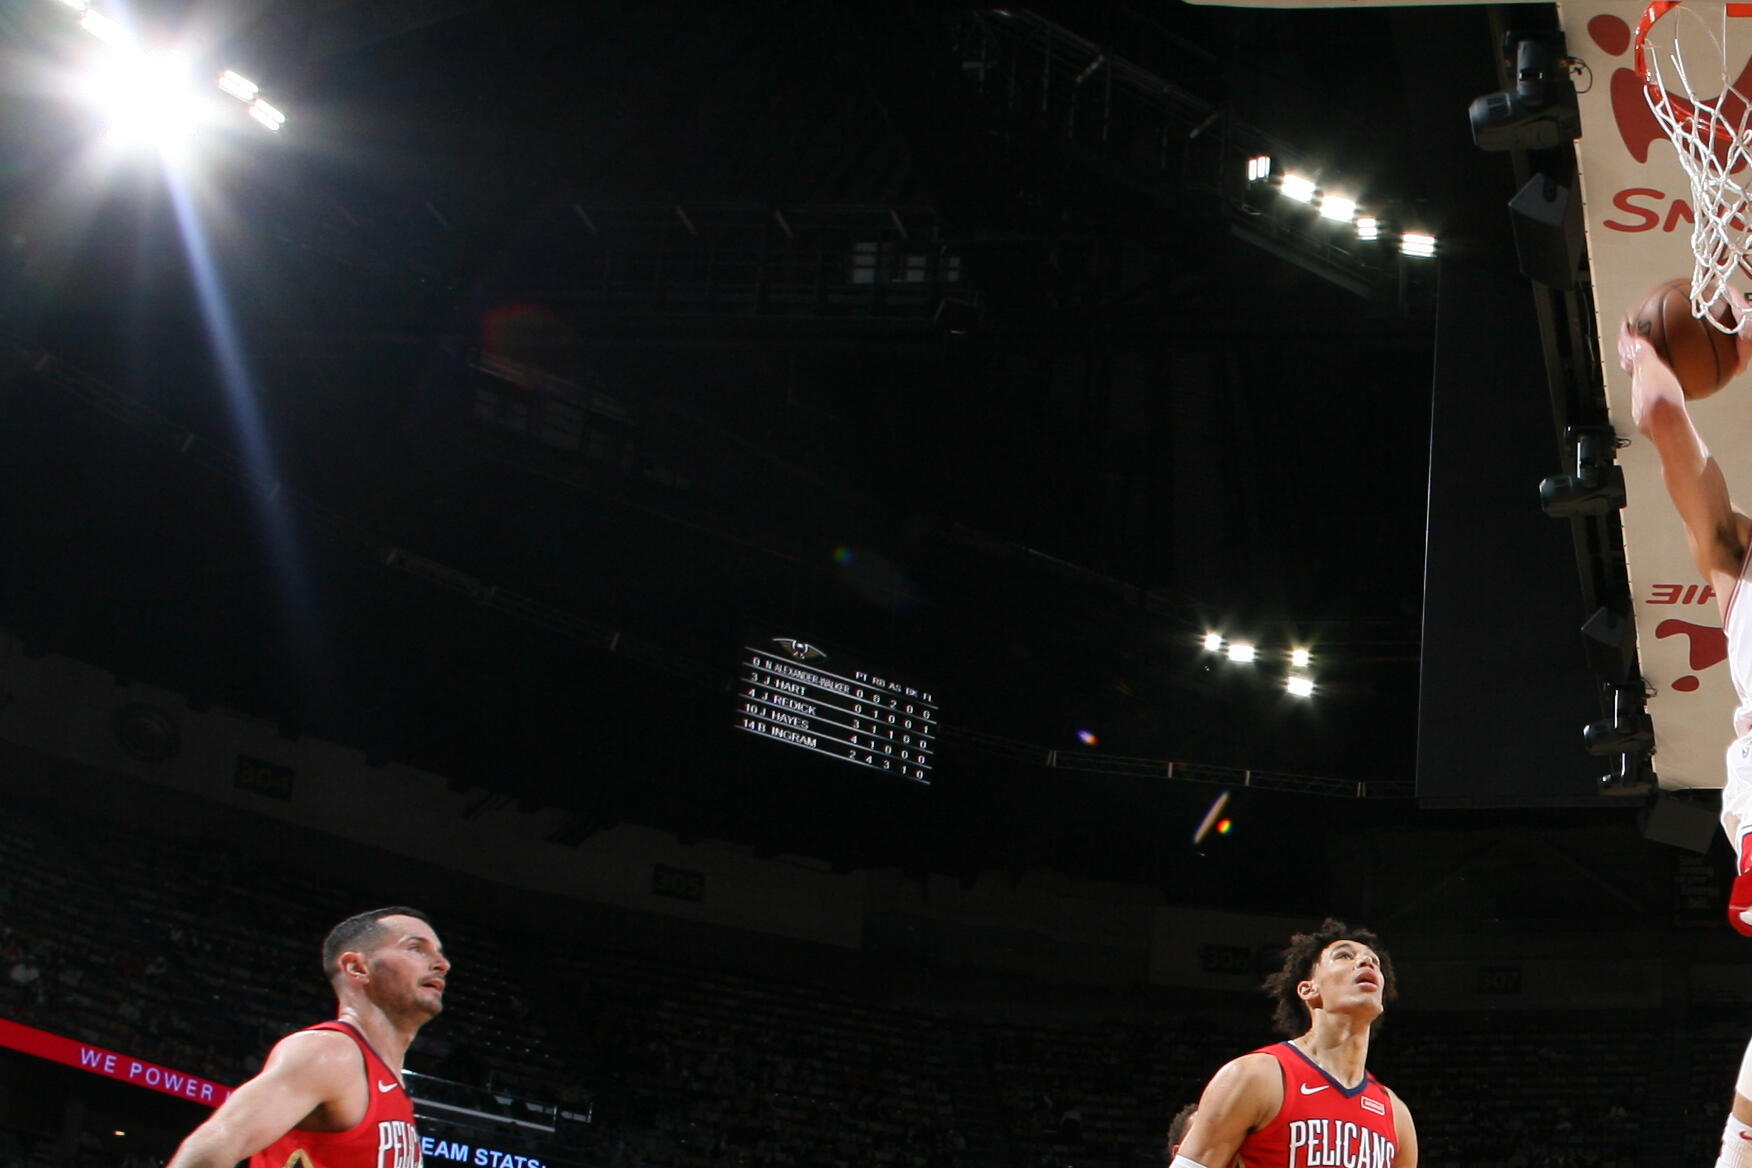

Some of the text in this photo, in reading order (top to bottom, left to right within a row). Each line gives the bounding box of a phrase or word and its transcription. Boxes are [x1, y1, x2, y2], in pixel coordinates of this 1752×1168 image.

[775, 679, 806, 696] HART
[773, 695, 817, 716] REDICK
[771, 710, 809, 730] HAYES
[771, 724, 817, 749] INGRAM
[80, 1048, 214, 1101] WE POWER
[420, 1136, 469, 1163] EAM
